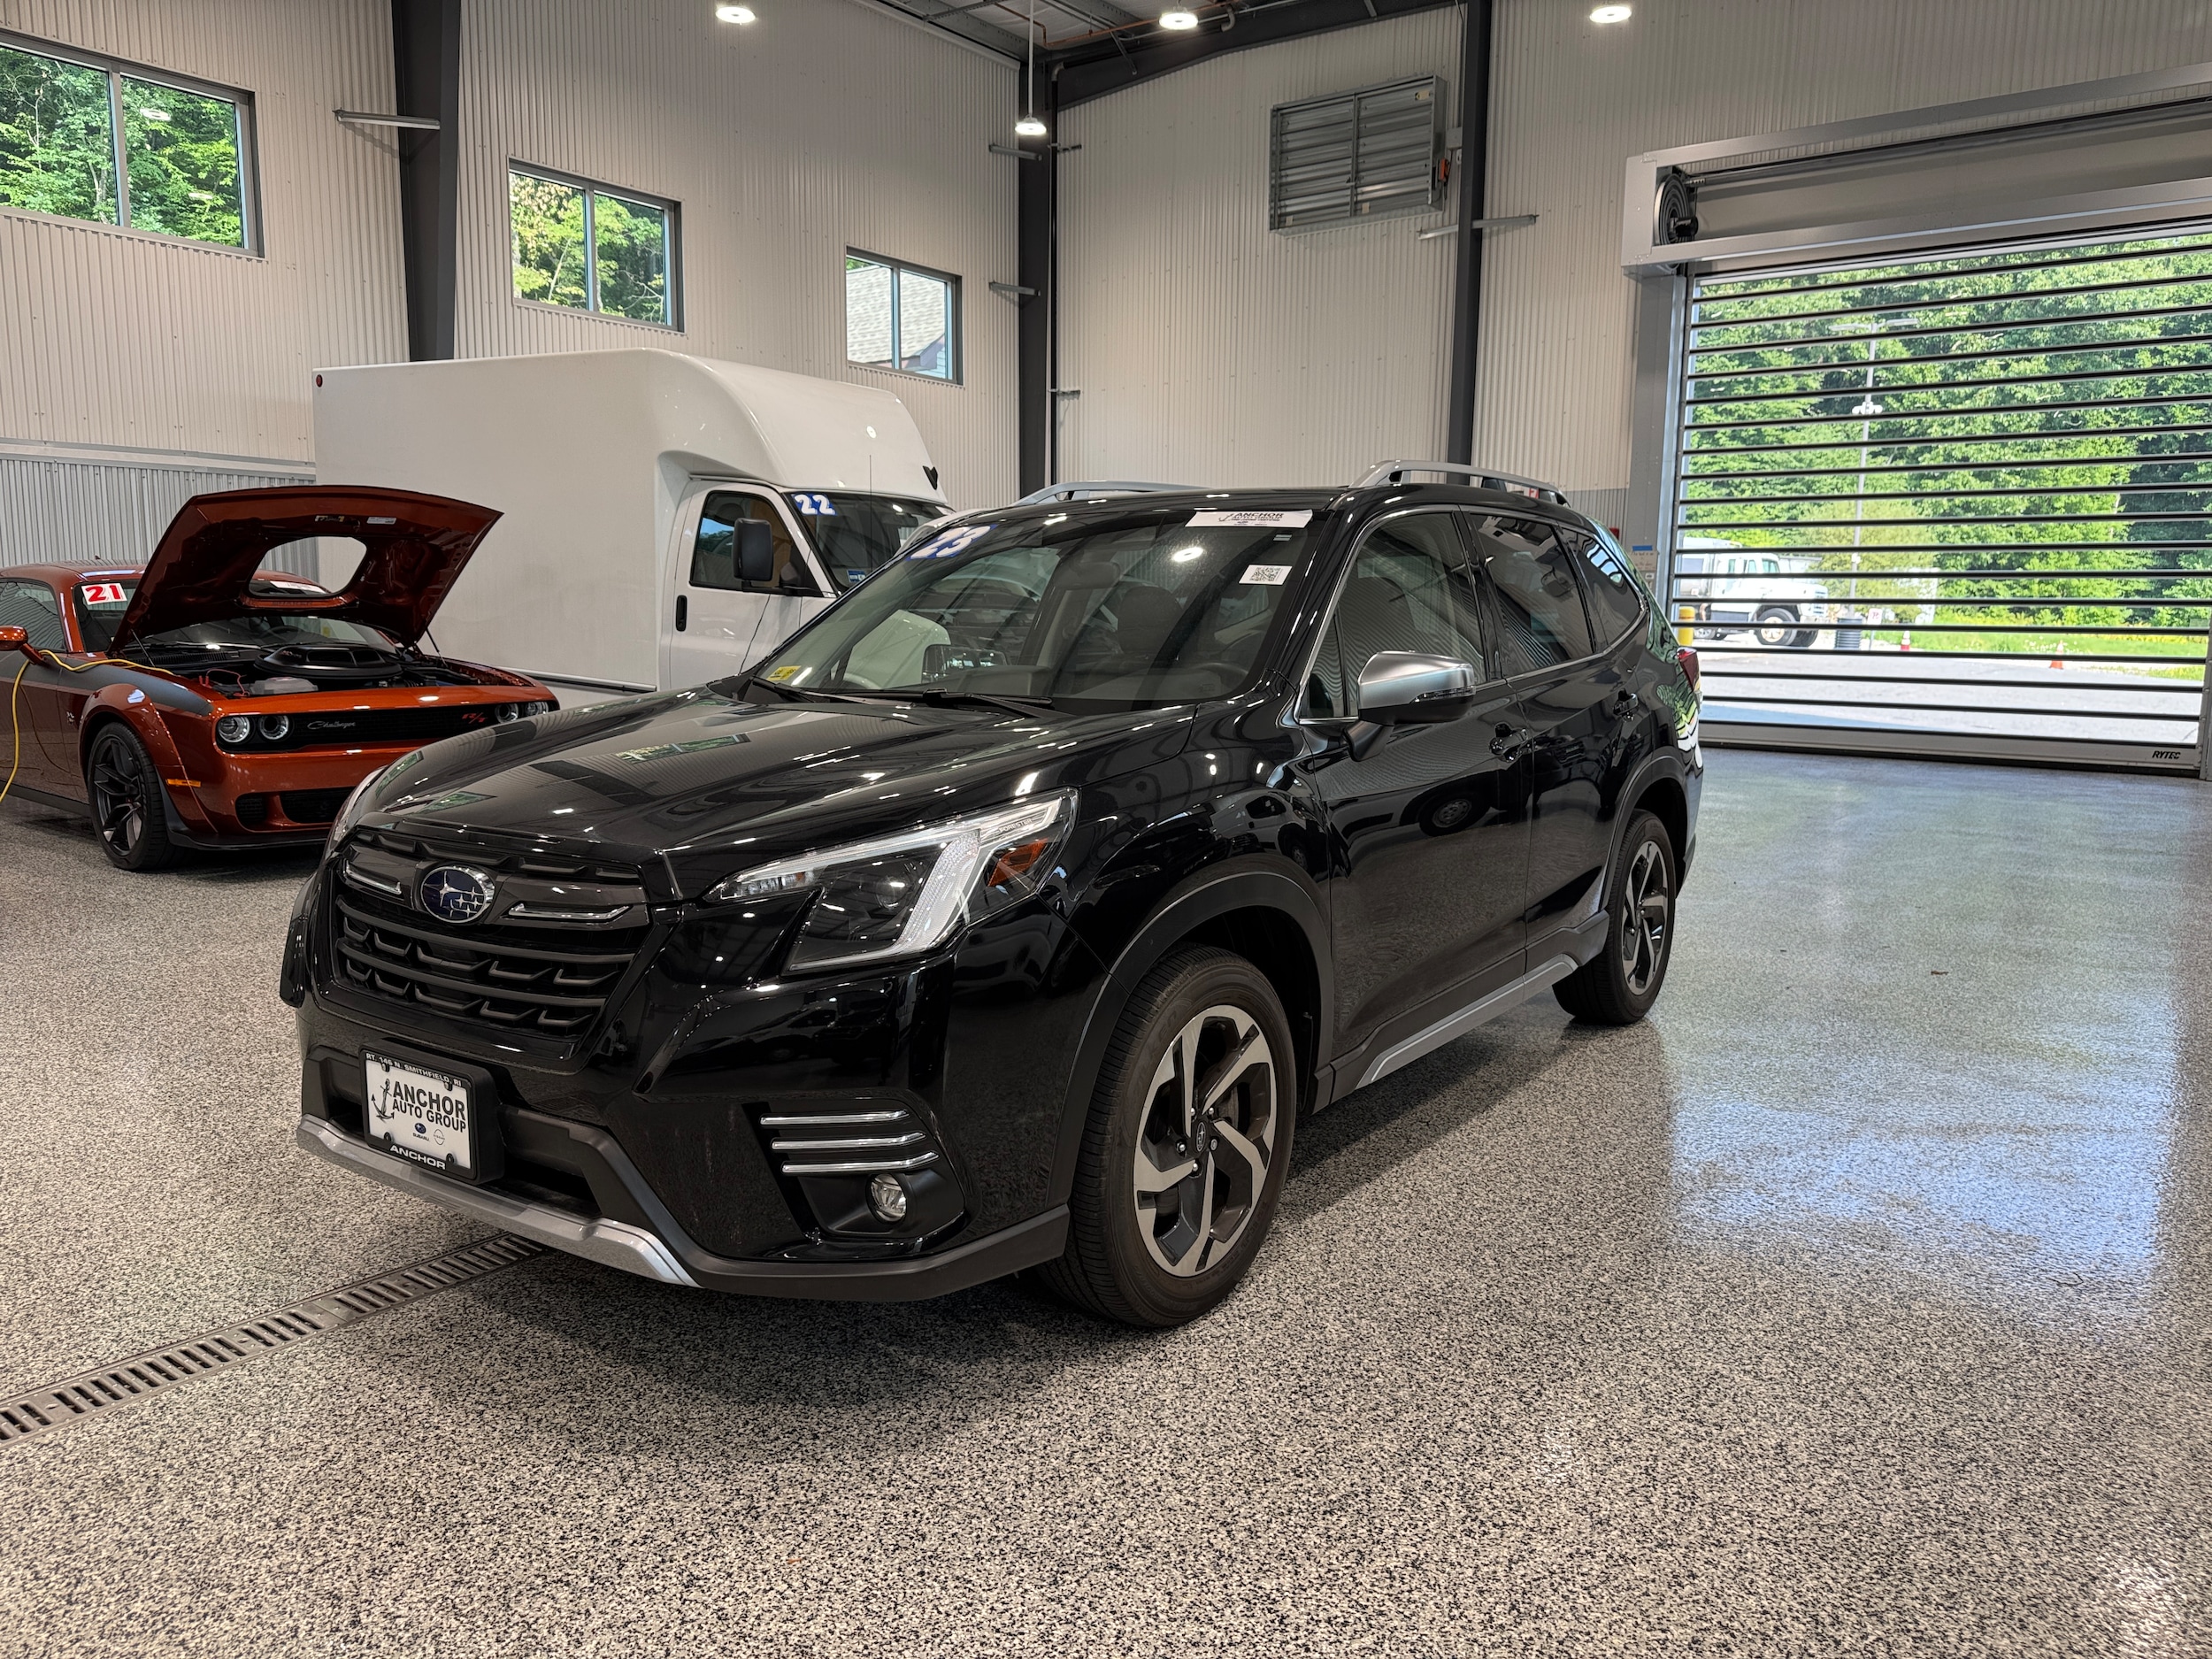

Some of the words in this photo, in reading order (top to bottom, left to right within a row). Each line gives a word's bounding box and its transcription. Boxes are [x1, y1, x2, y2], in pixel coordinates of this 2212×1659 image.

[794, 494, 836, 515] 22
[910, 526, 991, 558] 23
[85, 585, 121, 603] 21
[2152, 750, 2181, 759] RYTEC
[999, 818, 1033, 833] FORESTER
[379, 1056, 394, 1066] 146
[453, 1078, 462, 1087] RI
[393, 1080, 466, 1121] ANCHOR
[392, 1098, 422, 1119] AUTO
[426, 1110, 466, 1133] GROUP
[390, 1145, 446, 1170] ANCHOR
